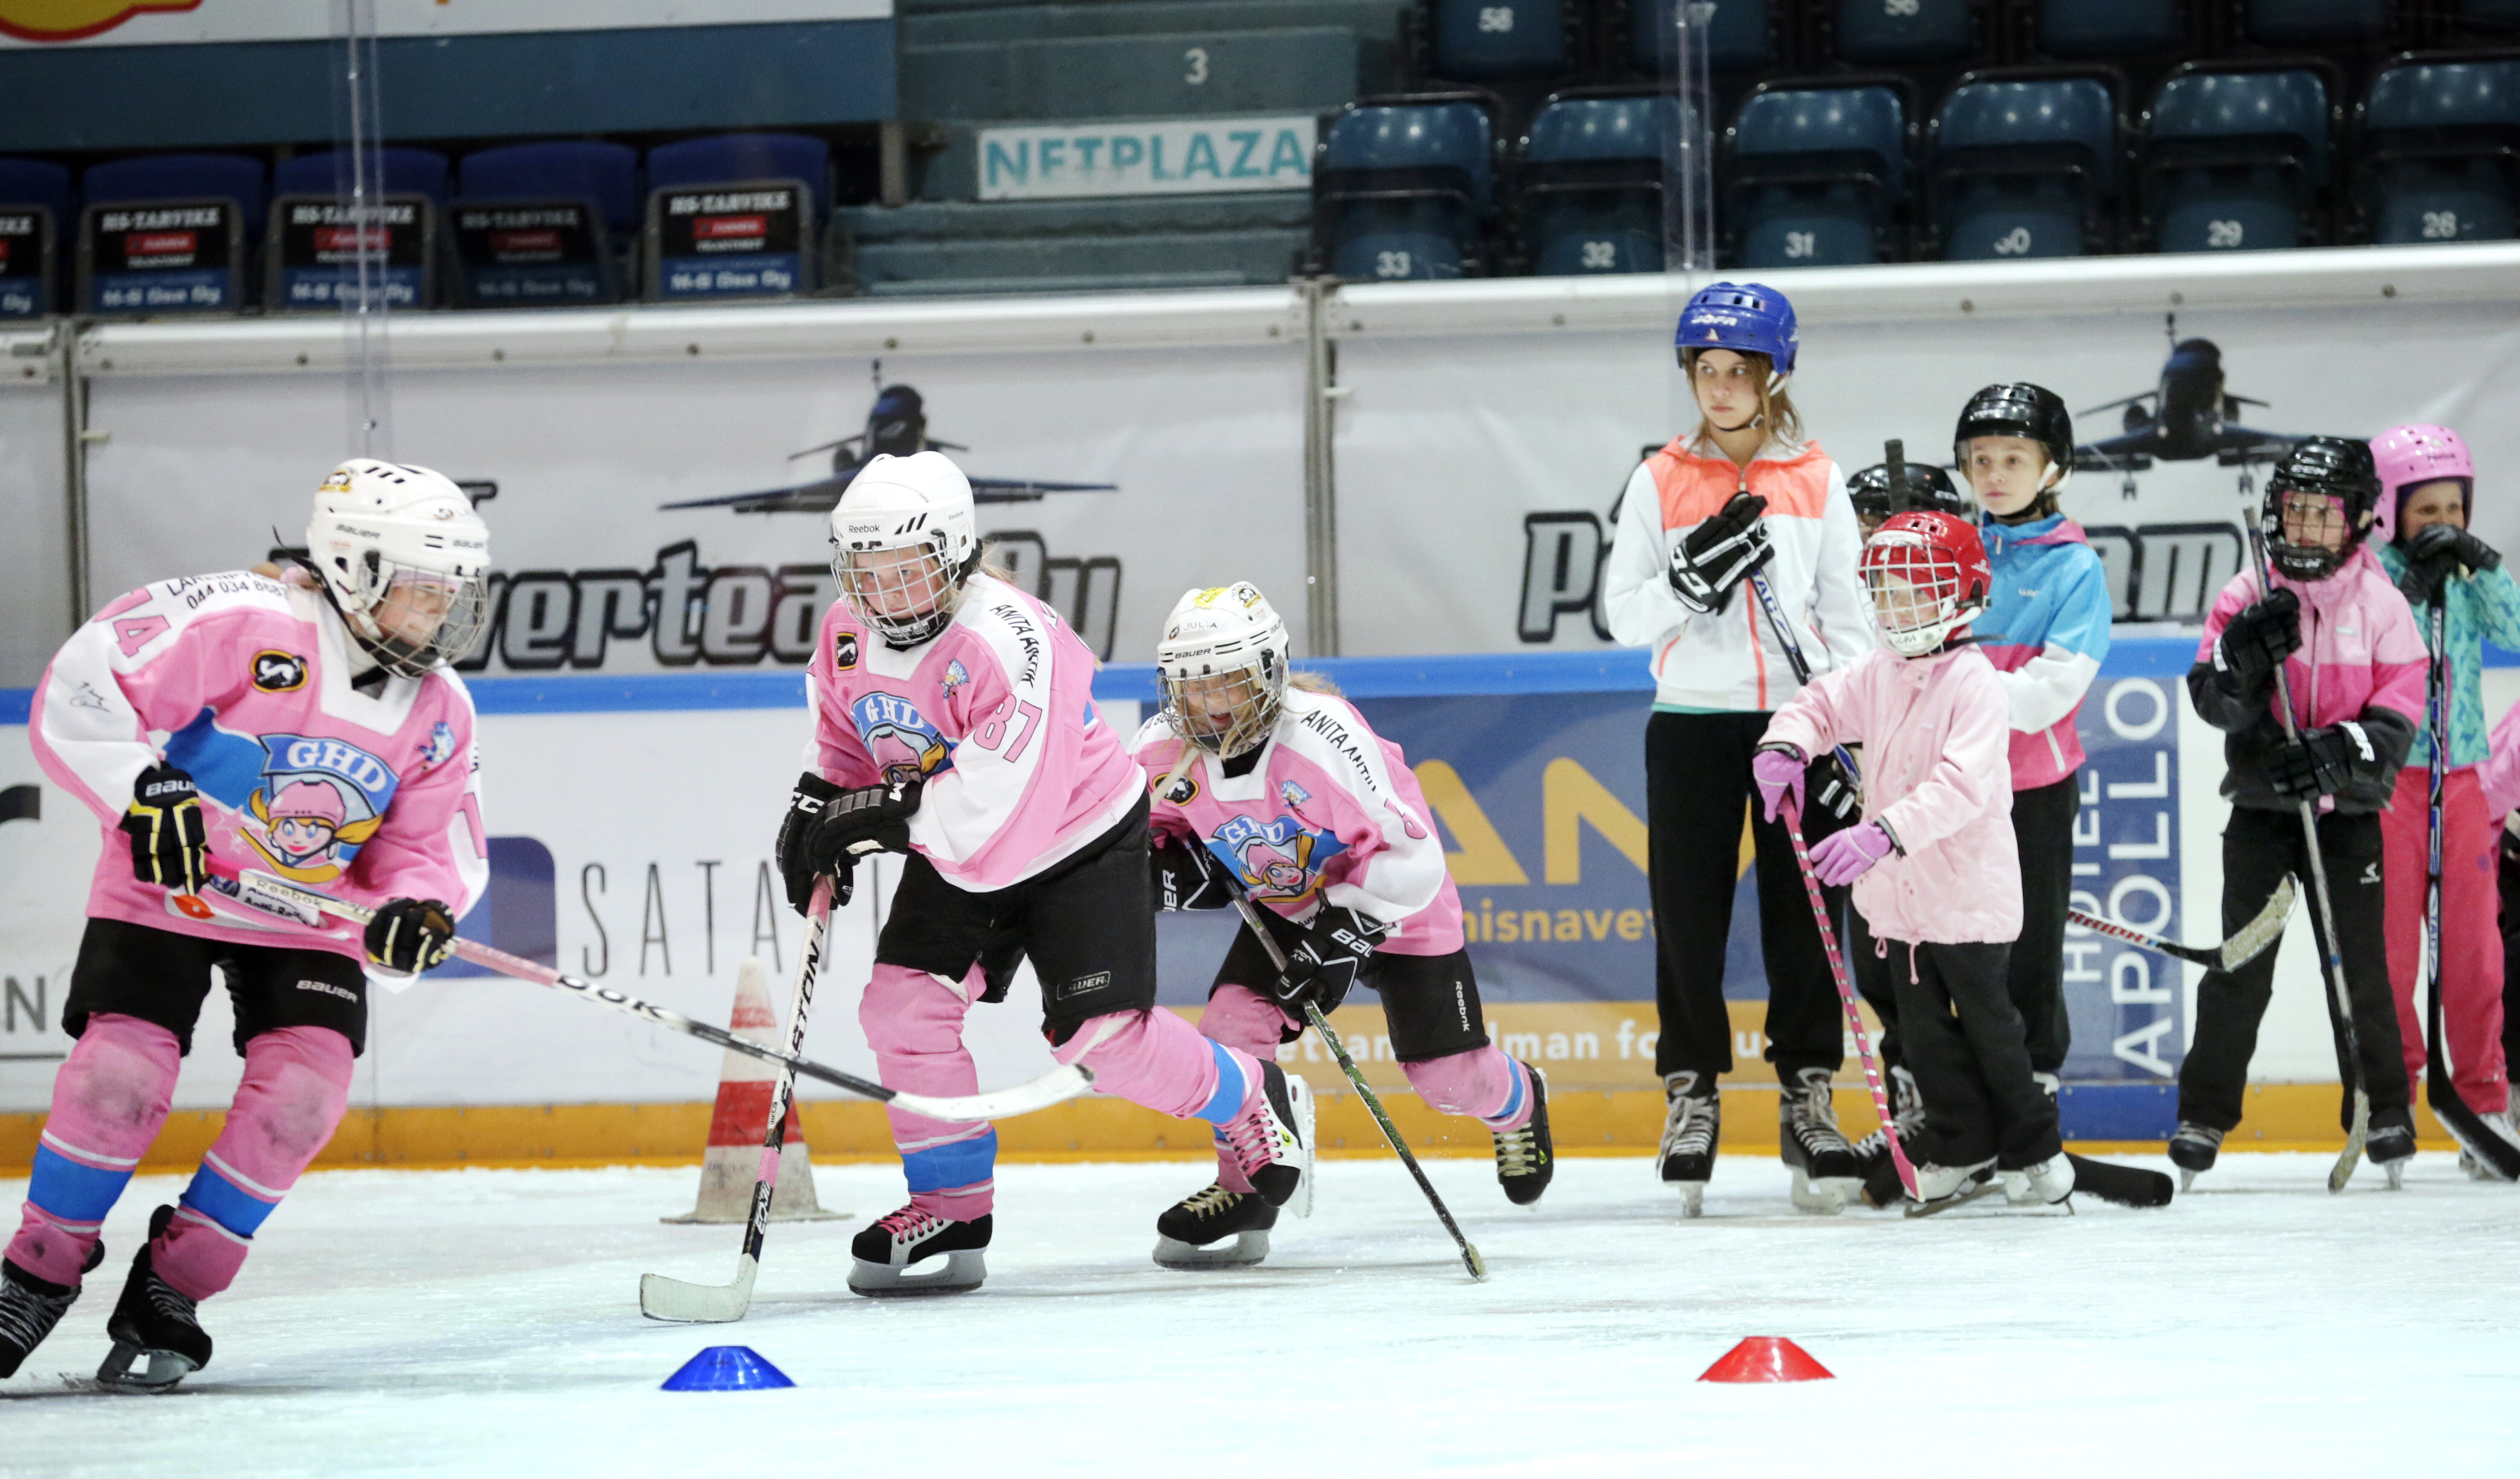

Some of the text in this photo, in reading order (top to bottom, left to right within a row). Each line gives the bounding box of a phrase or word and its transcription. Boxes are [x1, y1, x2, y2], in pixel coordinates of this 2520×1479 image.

[1184, 48, 1208, 84] 3
[2208, 220, 2243, 247] 29
[2423, 211, 2457, 238] 28
[1582, 241, 1615, 268] 32
[1785, 232, 1814, 258] 31
[1376, 251, 1411, 277] 33
[848, 524, 881, 534] Reebok
[187, 584, 215, 609] 044
[989, 605, 1035, 636] ANITA
[1175, 648, 1211, 659] BAUER
[865, 696, 925, 728] GHD
[973, 693, 1043, 763] 87
[1301, 710, 1349, 749] ANITA
[287, 741, 387, 792] GHD
[2105, 677, 2174, 1078] APOLLO
[296, 979, 358, 1004] BAUER
